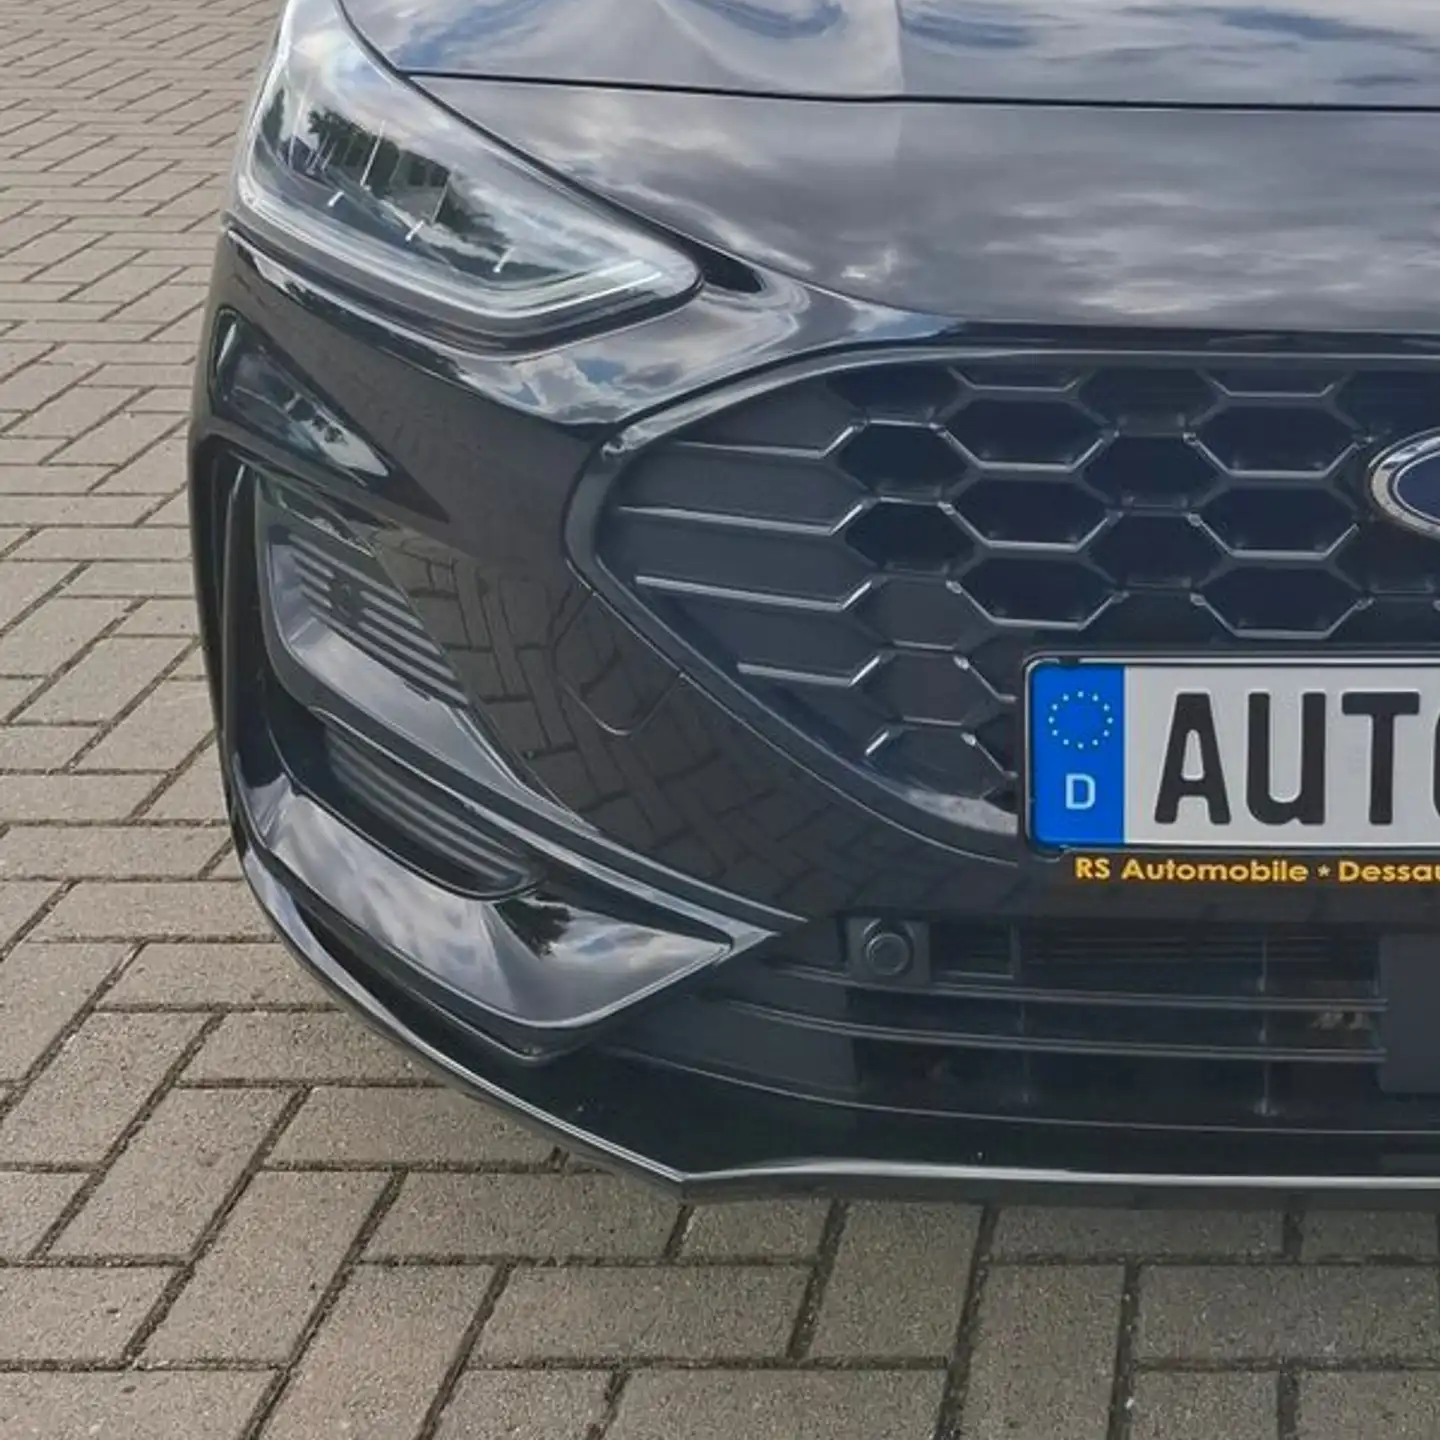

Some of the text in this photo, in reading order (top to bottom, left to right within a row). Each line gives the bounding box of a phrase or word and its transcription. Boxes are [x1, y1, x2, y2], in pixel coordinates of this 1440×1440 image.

[1066, 774, 1096, 810] D
[1075, 857, 1110, 880] RS
[1121, 859, 1309, 883] Automobile
